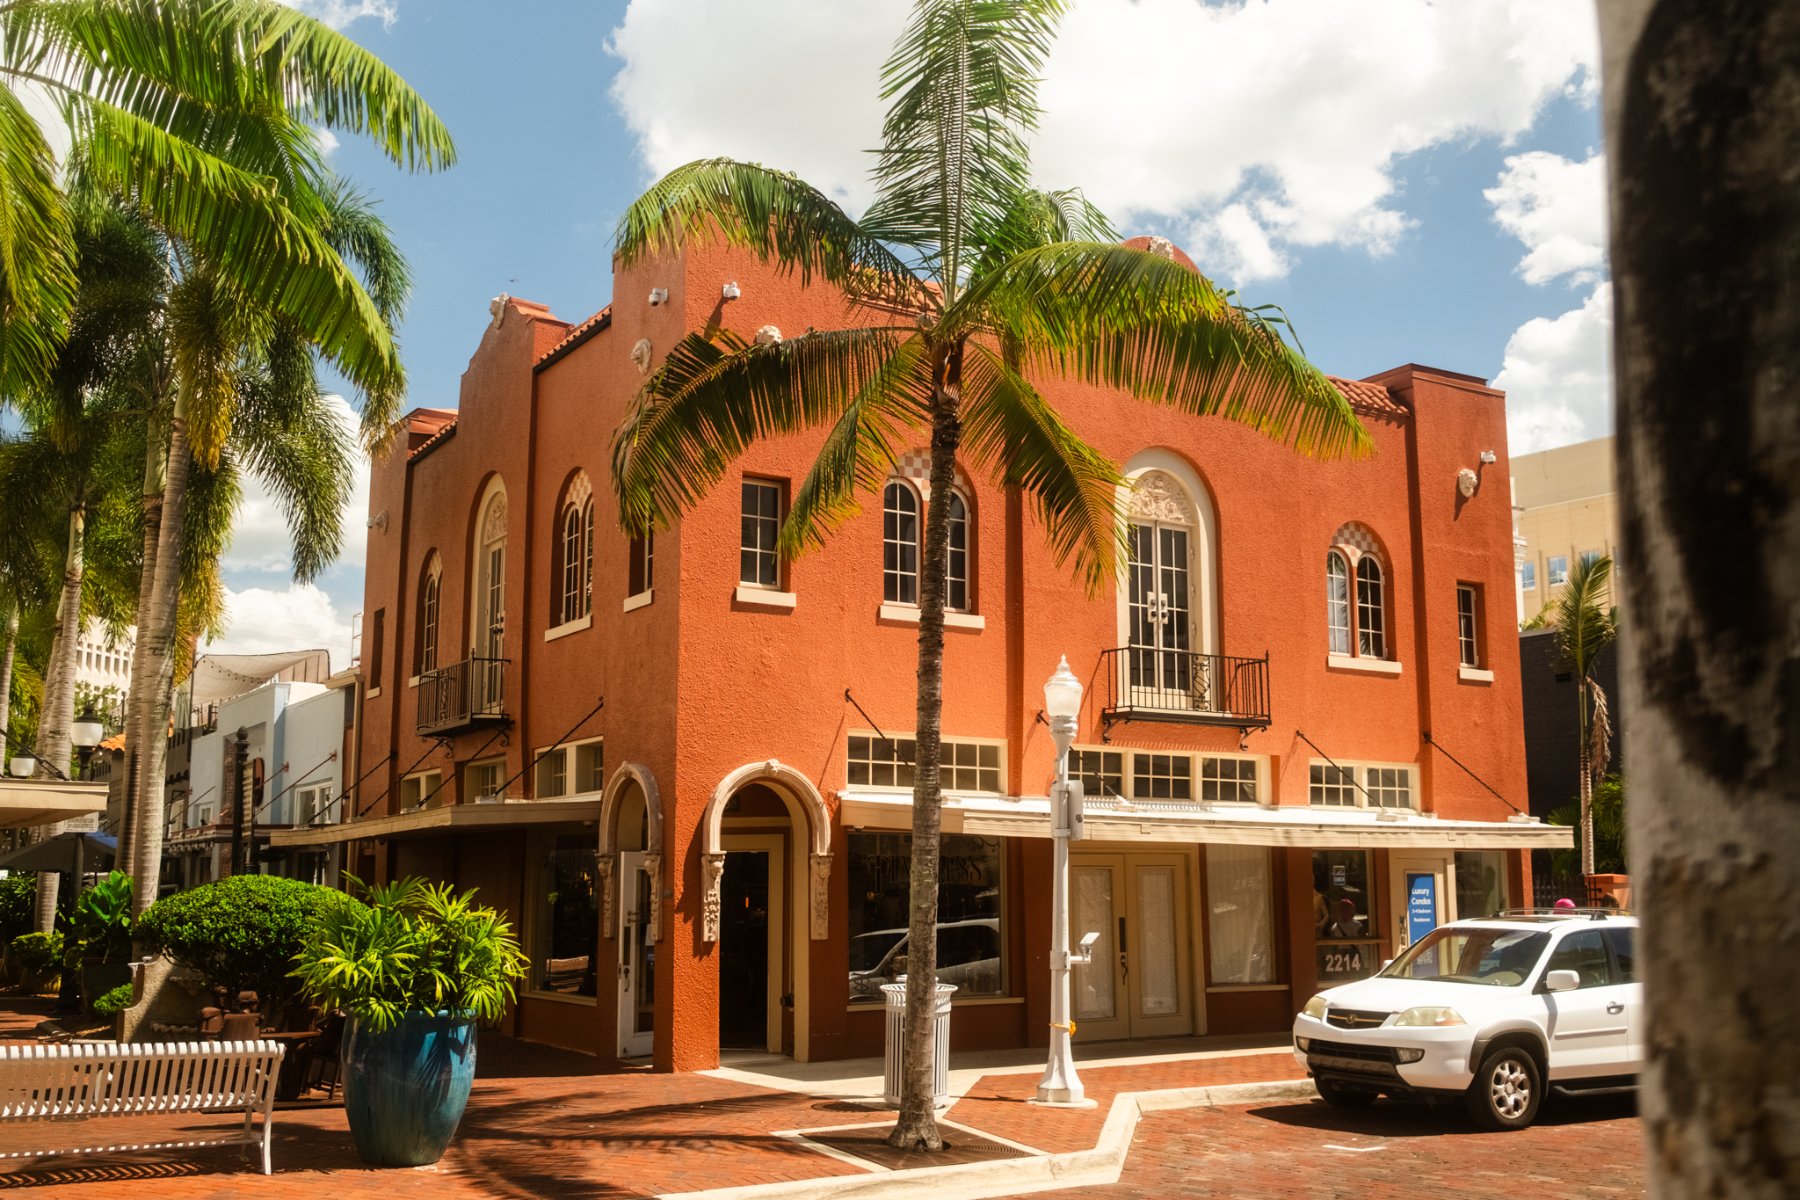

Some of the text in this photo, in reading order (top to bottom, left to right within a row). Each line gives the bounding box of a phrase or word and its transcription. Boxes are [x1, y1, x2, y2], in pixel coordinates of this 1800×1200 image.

[1411, 888, 1430, 897] Luxury
[1411, 897, 1431, 905] Condos
[1325, 953, 1361, 972] 2214
